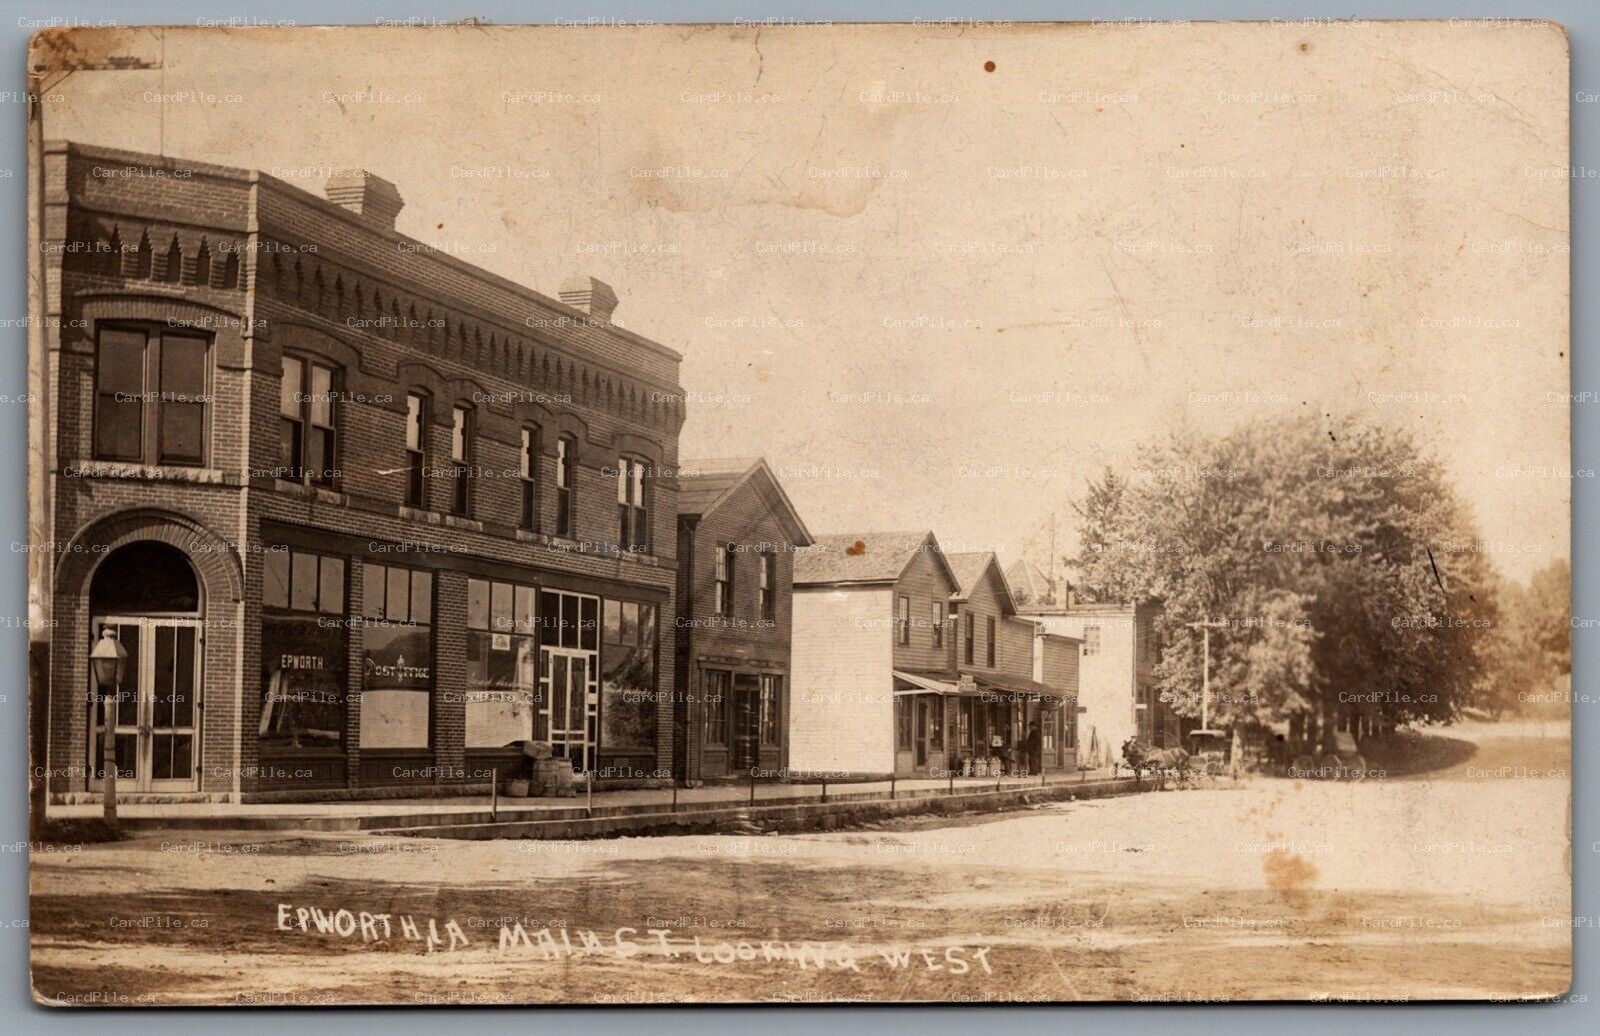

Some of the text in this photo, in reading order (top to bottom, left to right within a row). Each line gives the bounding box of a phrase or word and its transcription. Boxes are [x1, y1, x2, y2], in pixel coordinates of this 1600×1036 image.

[281, 654, 323, 669] EPWORTH
[366, 657, 395, 676] POST
[498, 922, 602, 960] MAIN
[694, 936, 860, 972] LOOKING
[877, 946, 992, 975] WEST
